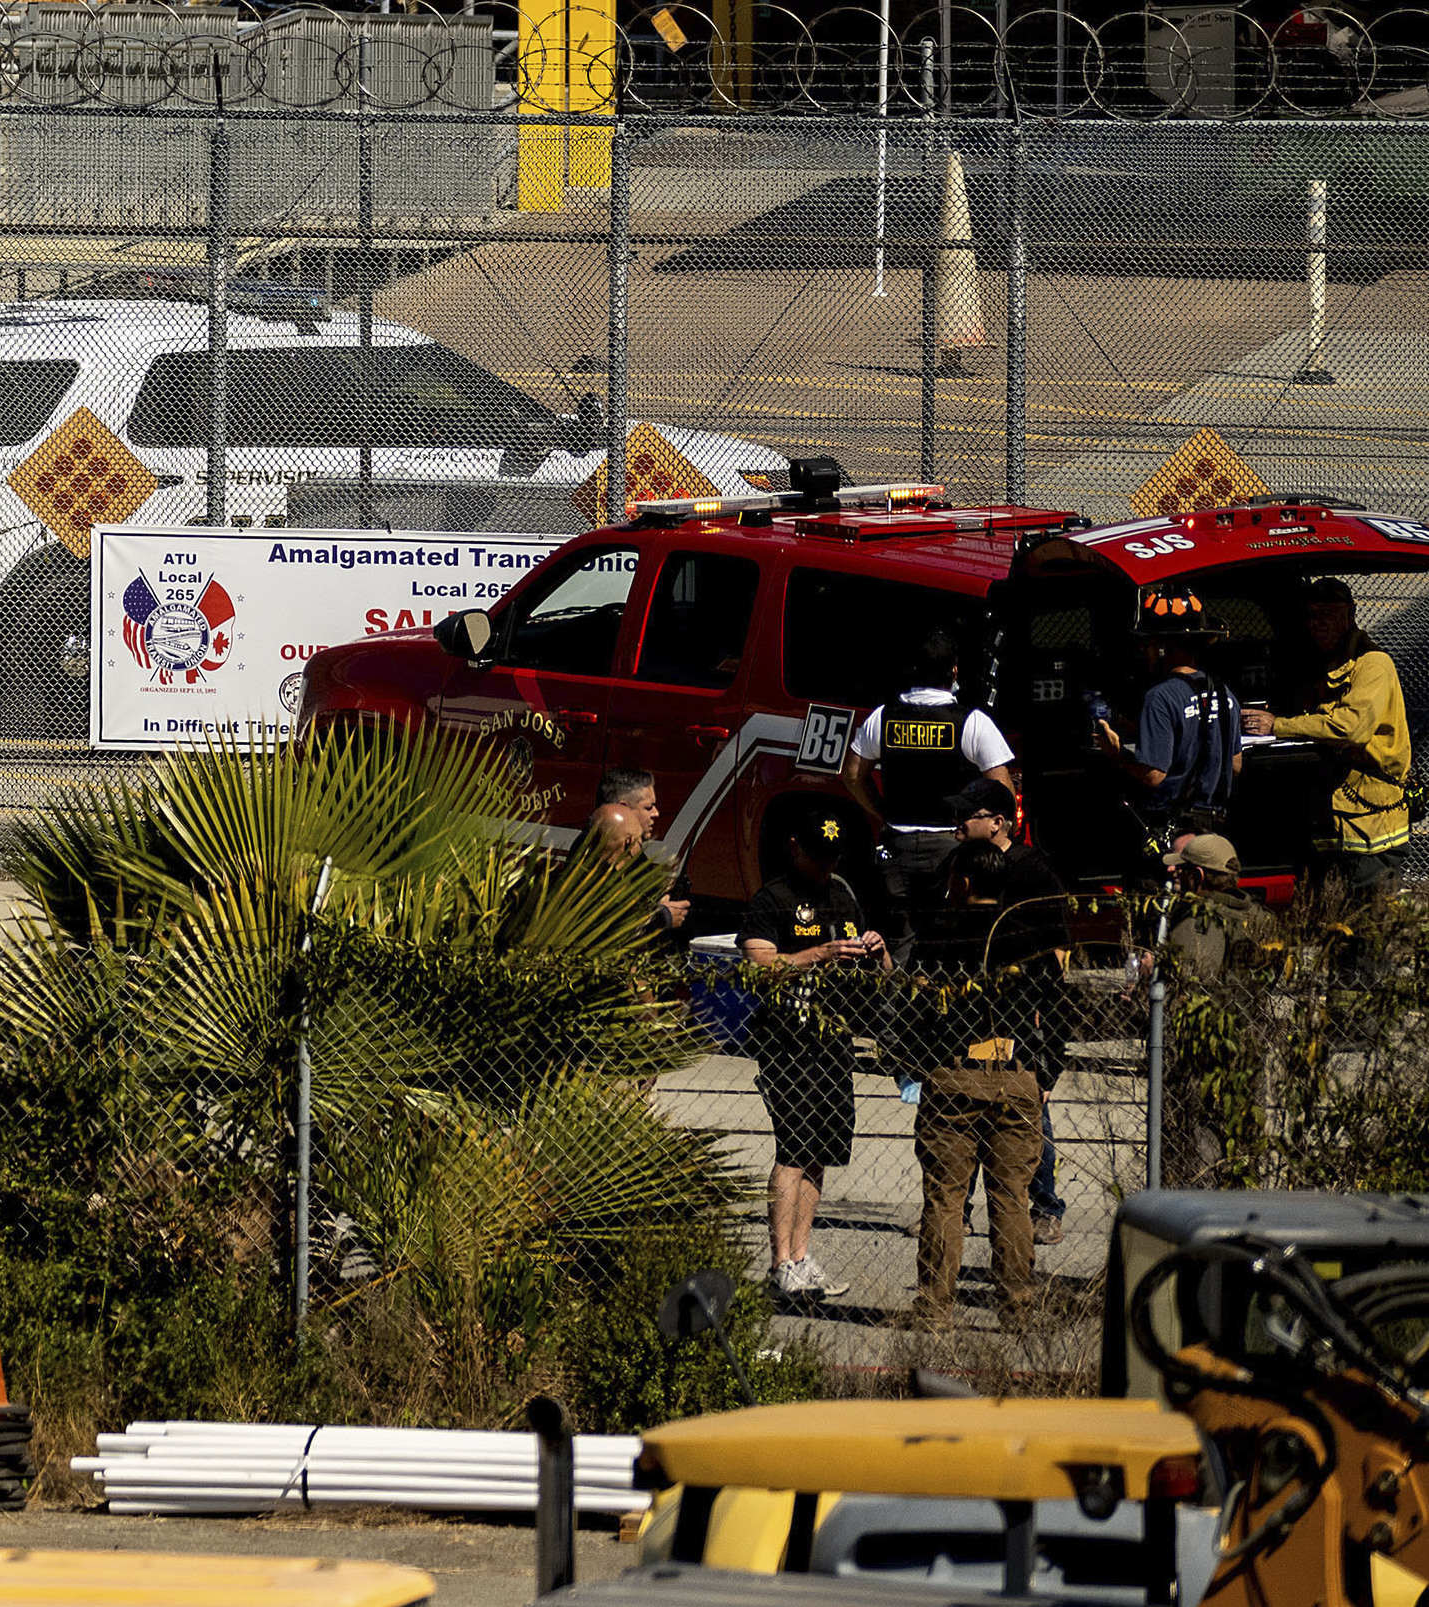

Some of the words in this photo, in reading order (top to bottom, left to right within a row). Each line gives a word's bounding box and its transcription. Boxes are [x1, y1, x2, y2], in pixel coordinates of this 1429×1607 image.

[1369, 518, 1429, 540] B5
[268, 544, 459, 570] Amalgamated
[469, 548, 555, 570] Trans
[1124, 534, 1195, 559] SJS
[163, 553, 197, 565] ATU
[159, 571, 202, 583] Local
[165, 589, 195, 601] 265
[411, 582, 467, 598] Local
[474, 582, 511, 598] 265
[148, 604, 207, 632] AMALGAMATED
[145, 640, 175, 670] TRANSIT
[184, 644, 207, 668] UNION
[143, 718, 160, 732] In
[167, 719, 239, 734] Difficult
[479, 708, 515, 738] SAN
[520, 710, 565, 750] JOSE
[893, 724, 945, 746] SHERIFF
[801, 712, 848, 764] B5
[521, 782, 567, 812] DEPT.
[794, 924, 821, 936] SHERIFF
